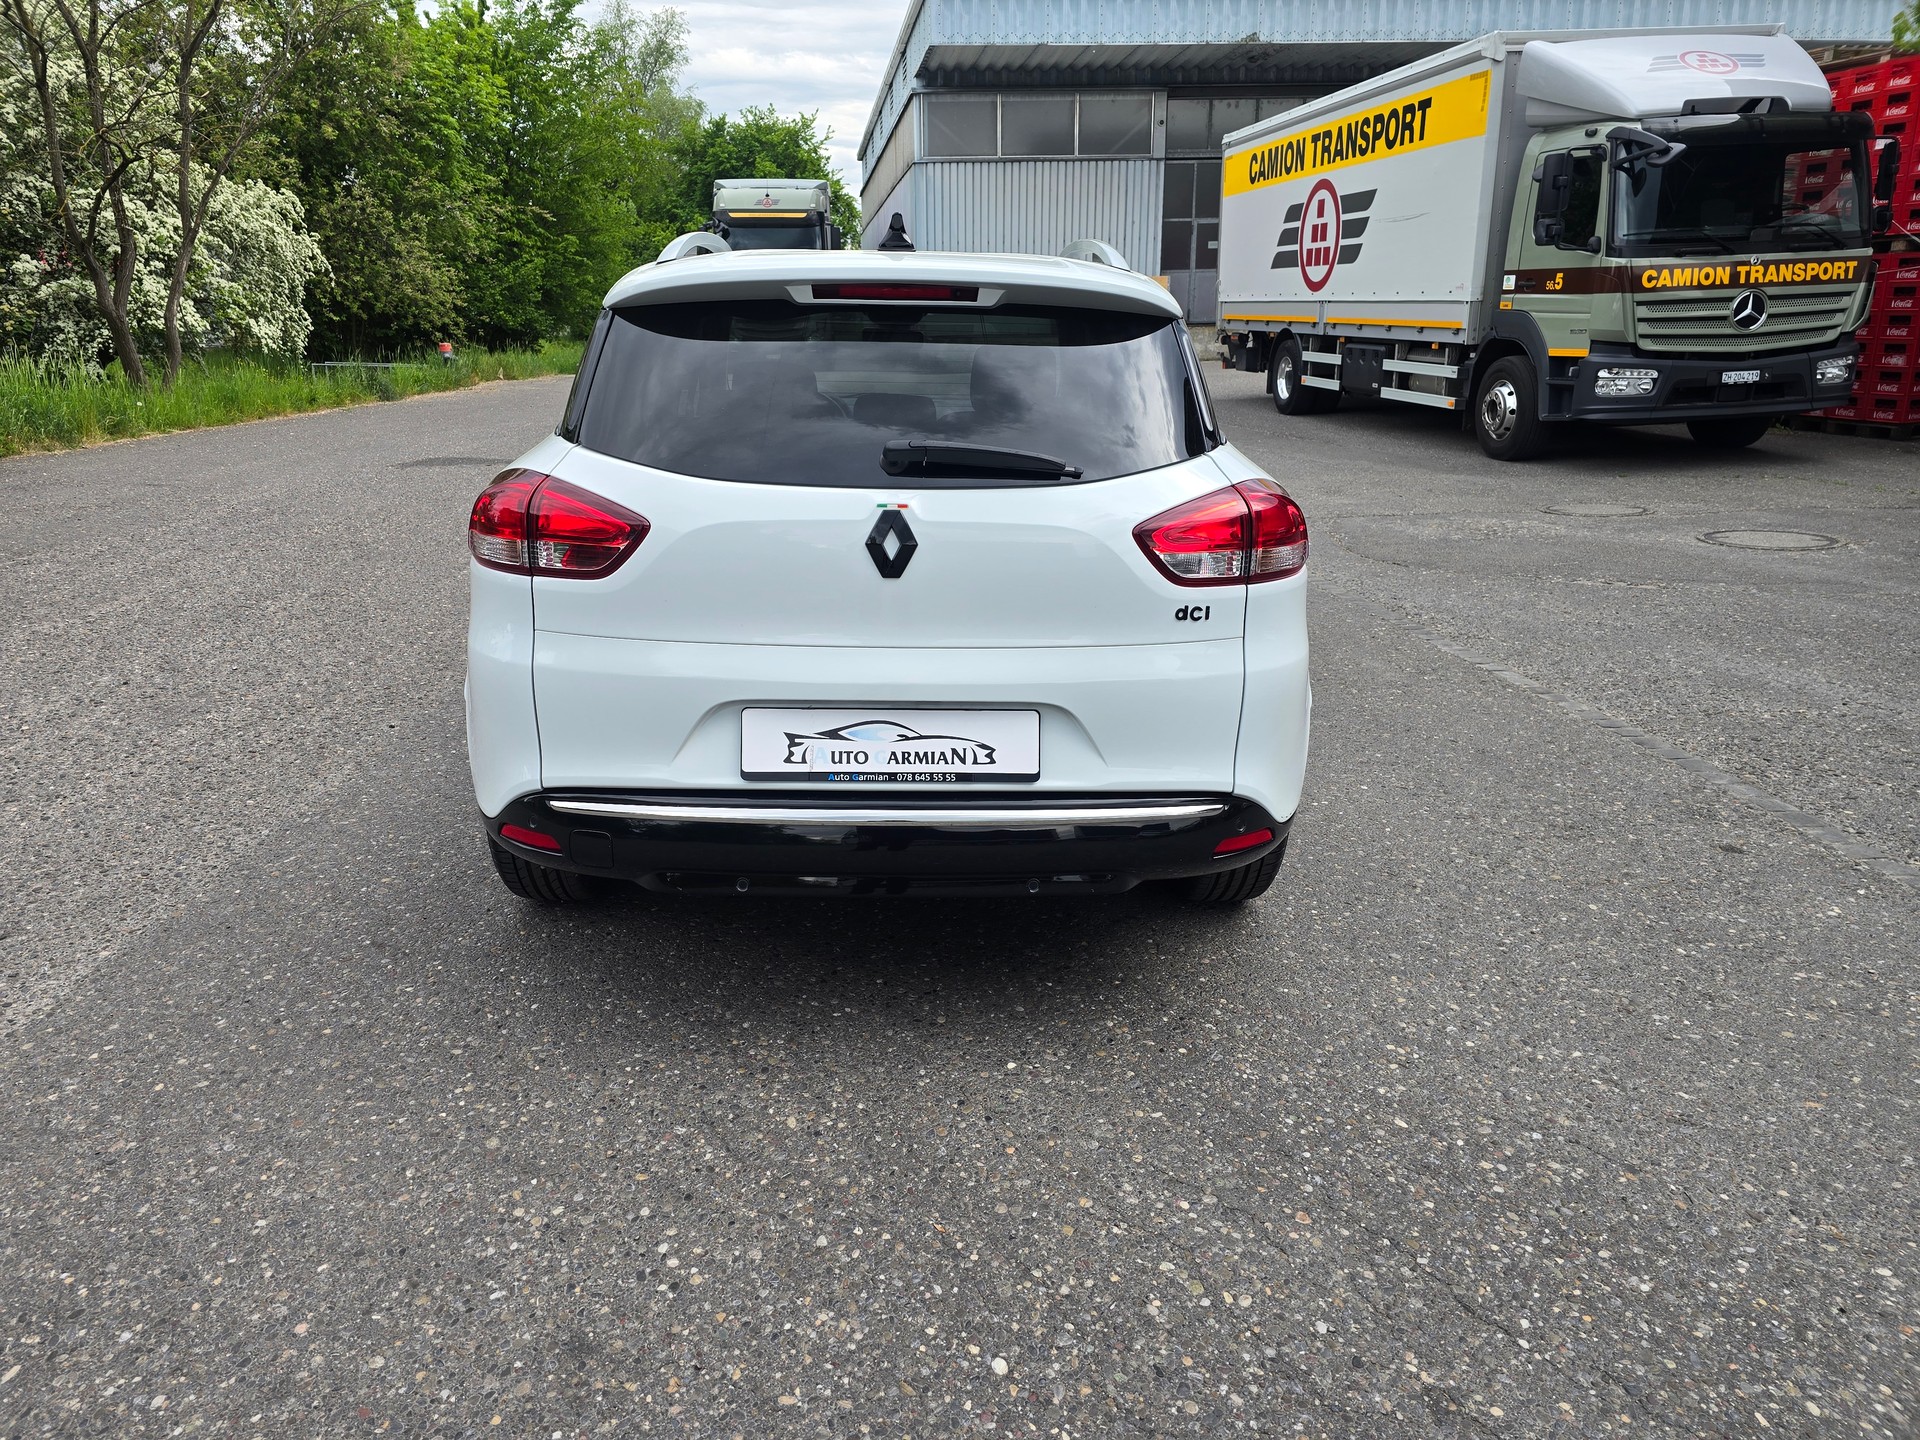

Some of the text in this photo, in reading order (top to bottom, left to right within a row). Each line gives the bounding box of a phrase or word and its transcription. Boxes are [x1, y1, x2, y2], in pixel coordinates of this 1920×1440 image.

[1248, 96, 1433, 185] CAMION TRANSPORT
[1641, 261, 1858, 289] CAMION TRANSPORT
[828, 773, 850, 782] Auto
[852, 773, 889, 782] Garmian
[896, 773, 913, 782] 078
[914, 773, 931, 782] 645
[932, 773, 944, 782] 55
[945, 773, 957, 782] 55
